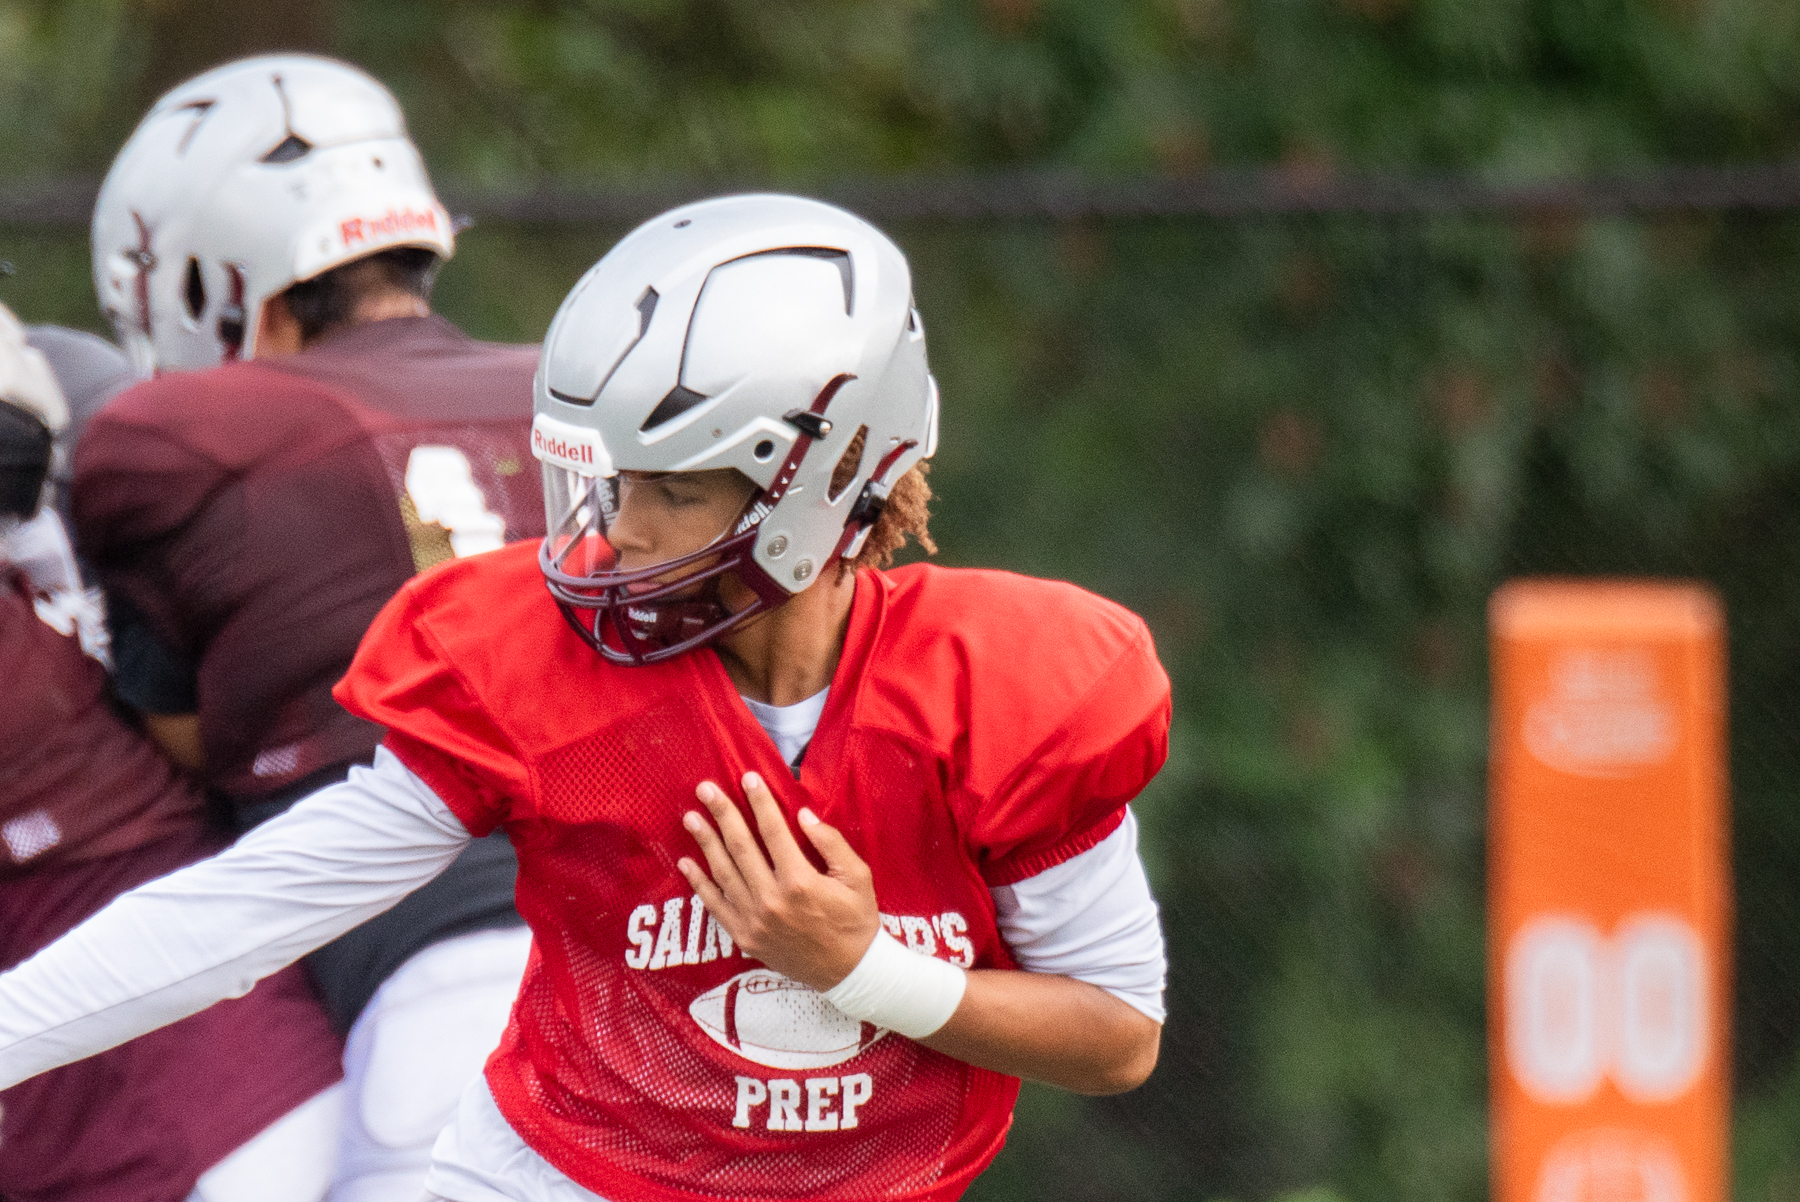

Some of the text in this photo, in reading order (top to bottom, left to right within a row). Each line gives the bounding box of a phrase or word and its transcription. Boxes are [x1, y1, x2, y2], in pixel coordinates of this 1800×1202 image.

[533, 427, 594, 464] Riddell
[625, 893, 751, 970] SAIN
[732, 1072, 873, 1132] PREP
